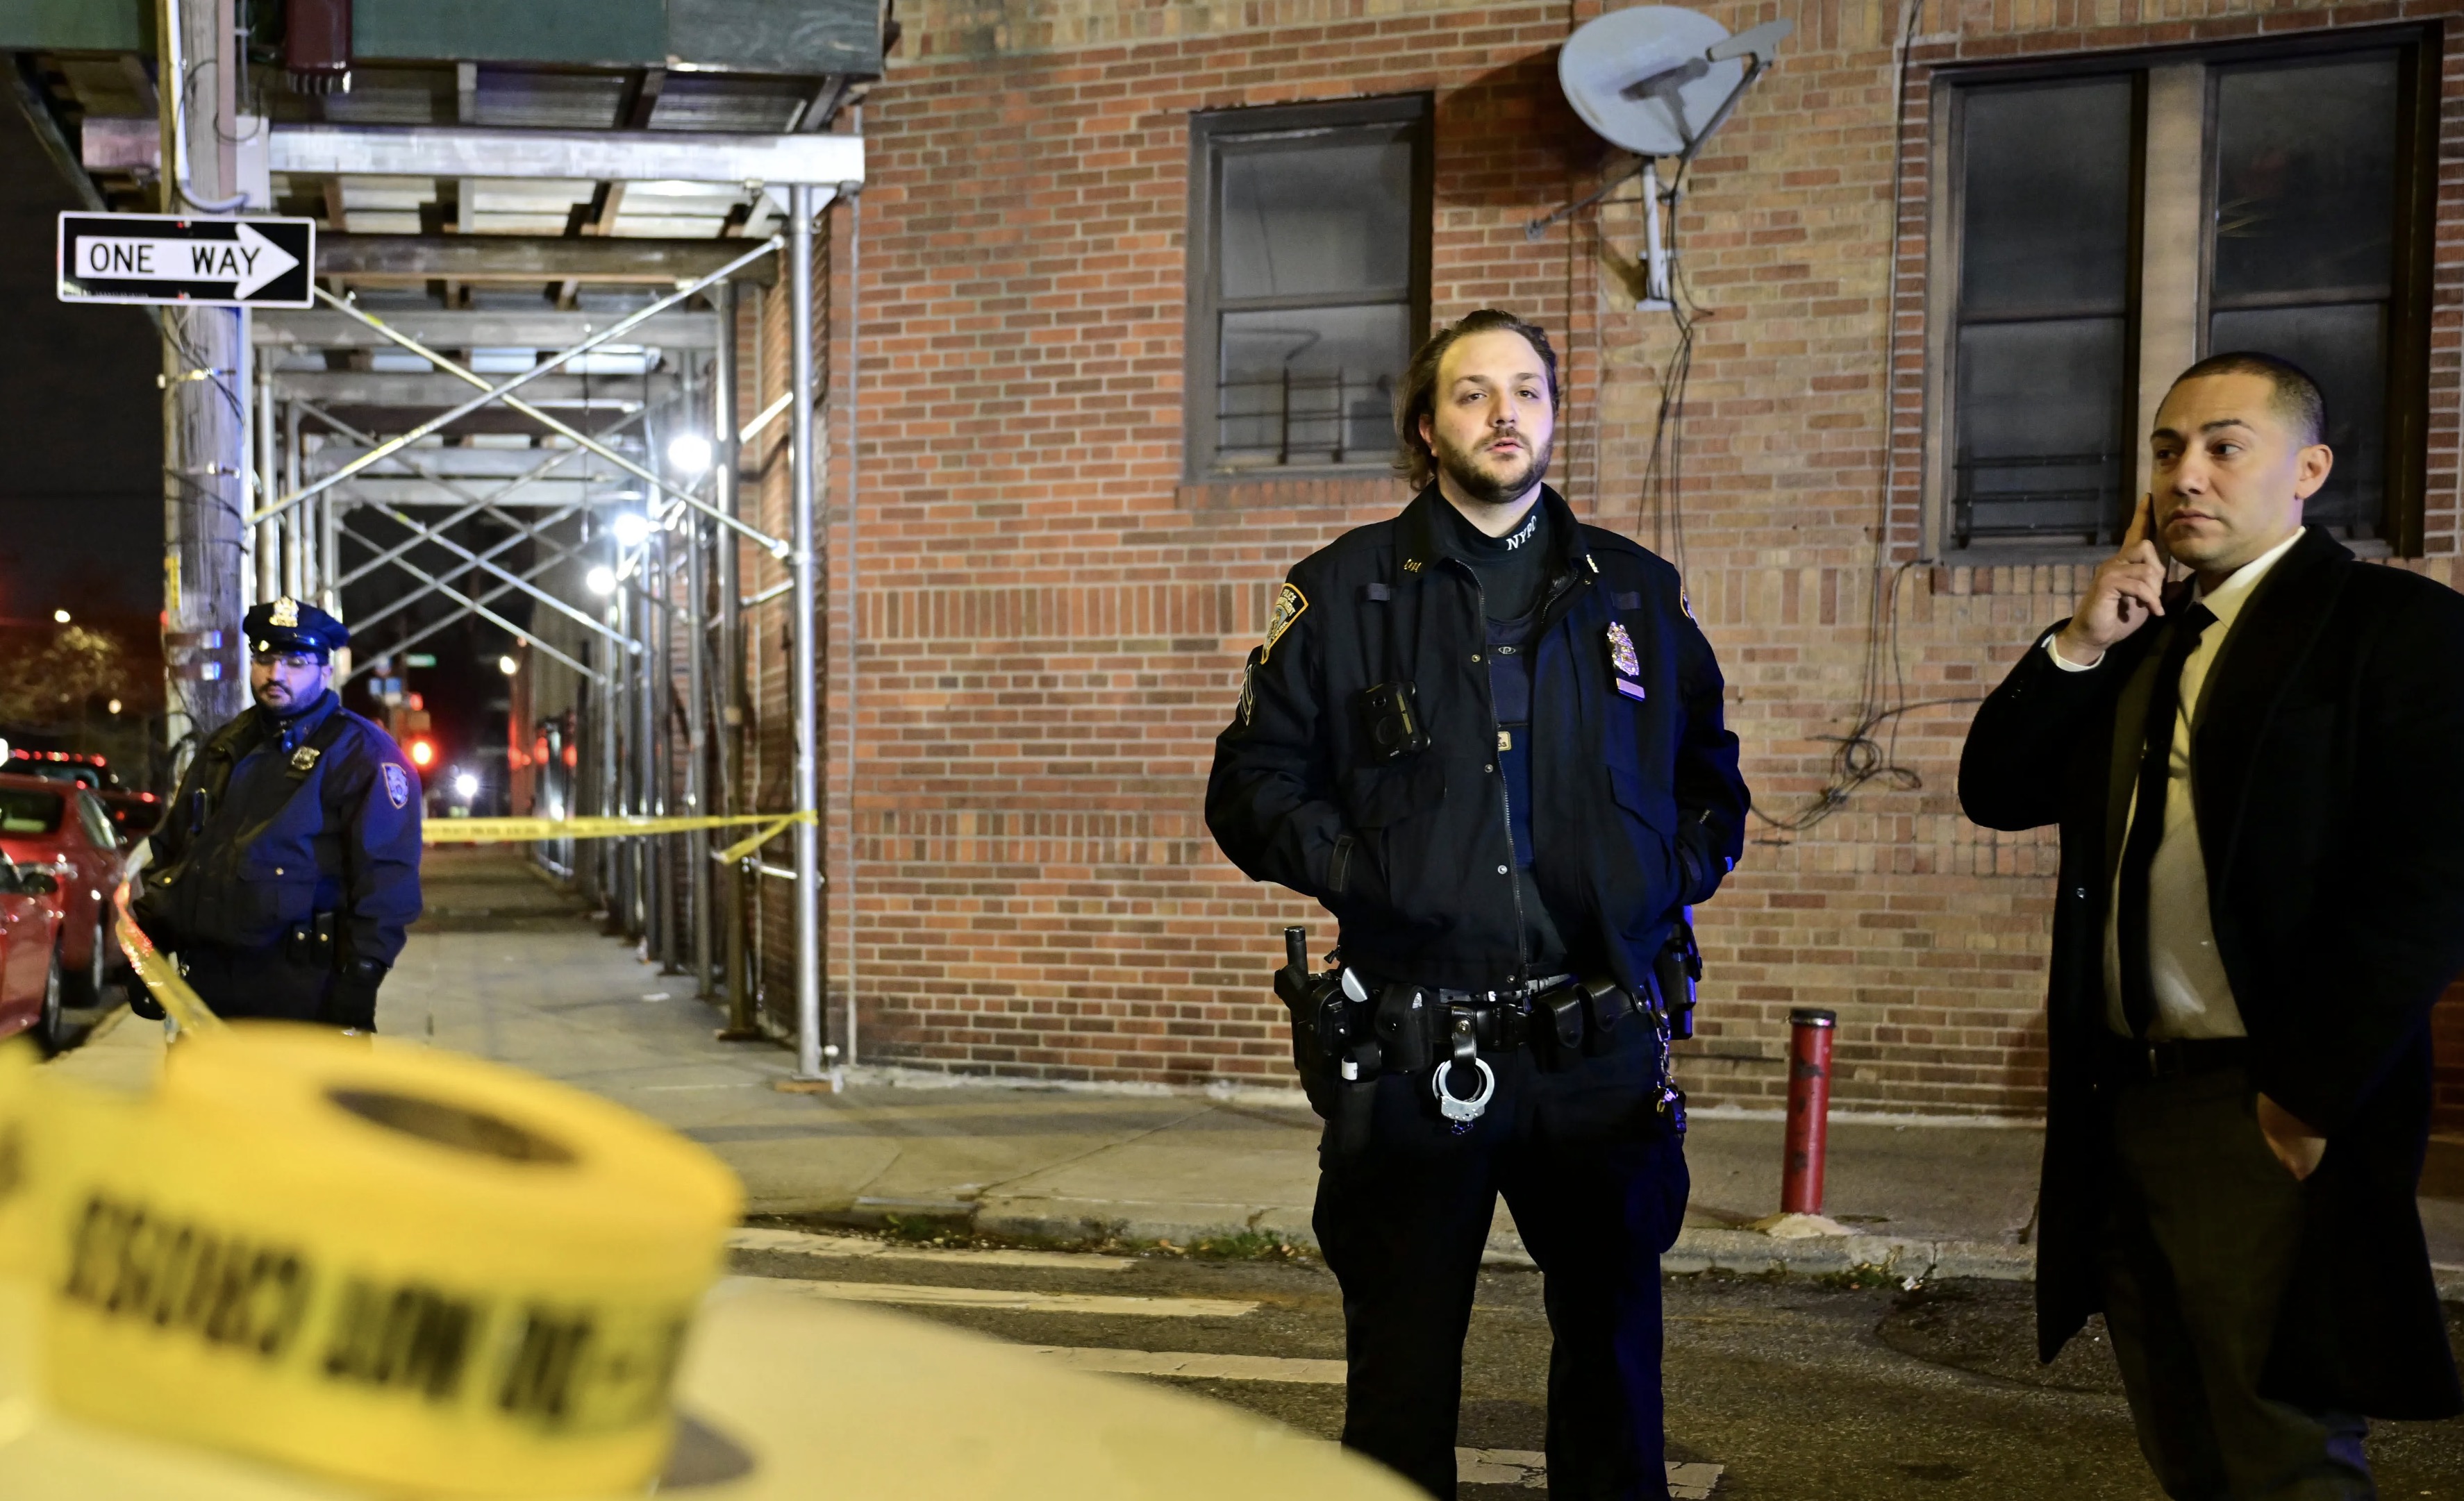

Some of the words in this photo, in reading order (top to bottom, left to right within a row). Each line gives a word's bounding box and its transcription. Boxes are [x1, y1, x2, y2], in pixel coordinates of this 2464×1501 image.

[90, 243, 154, 274] ONE
[192, 246, 261, 276] WAY
[1506, 515, 1537, 551] NYPD
[65, 1189, 313, 1357] CROSS
